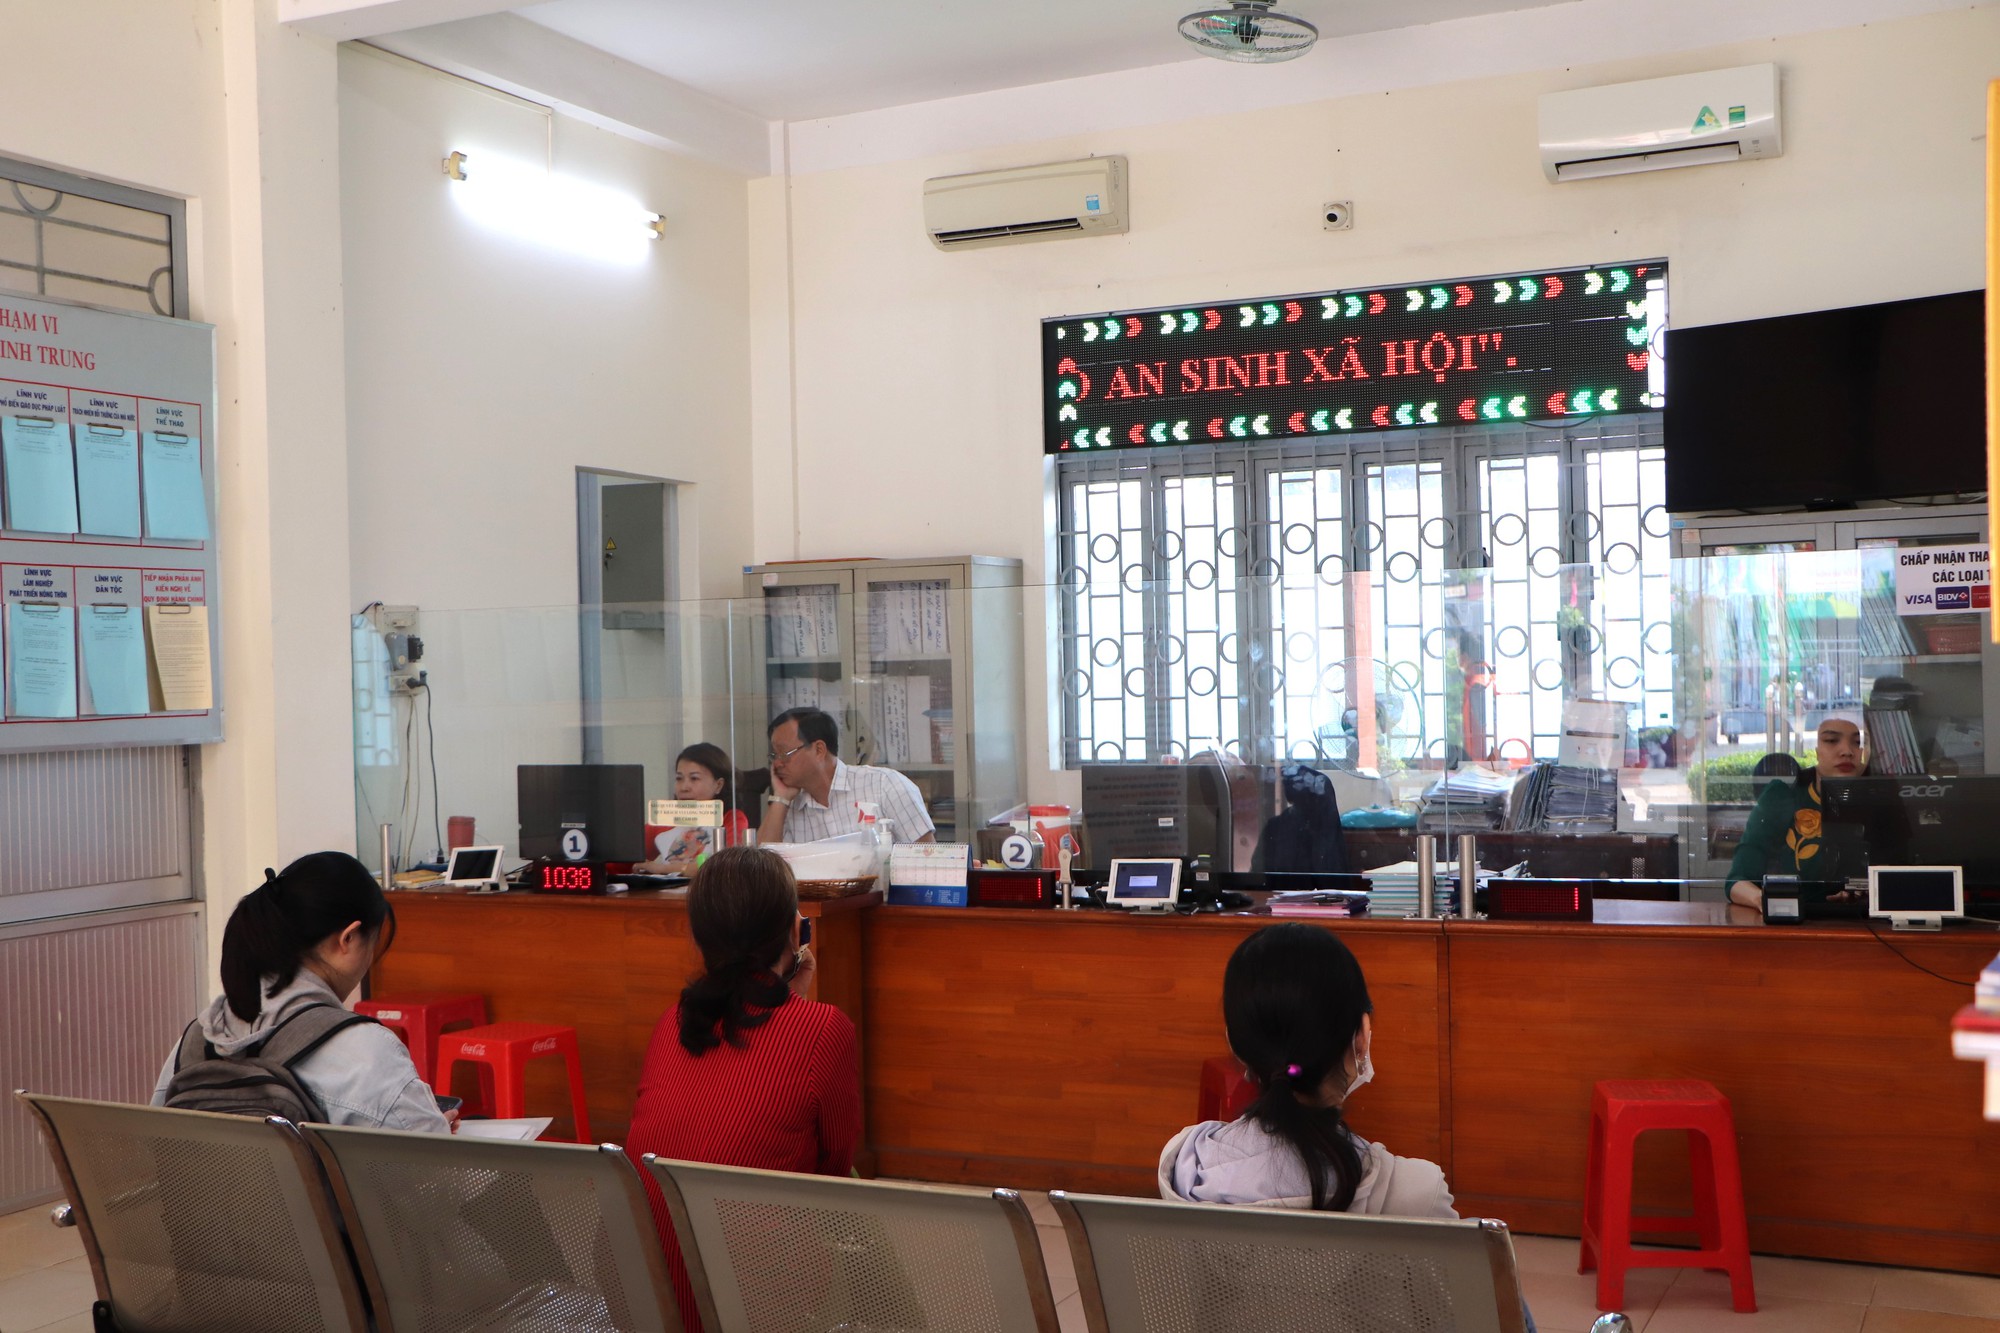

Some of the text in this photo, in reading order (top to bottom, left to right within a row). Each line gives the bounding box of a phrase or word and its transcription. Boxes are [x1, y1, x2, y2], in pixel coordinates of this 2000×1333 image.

[41, 315, 59, 335] VI
[37, 345, 96, 371] TRUNG
[1105, 361, 1168, 400] AN
[1181, 351, 1291, 394] SINH
[1302, 337, 1371, 383] XÃ
[169, 419, 184, 427] THAO
[1900, 550, 1930, 566] CHẤP
[1933, 550, 1965, 566] NHẬN
[1932, 569, 1955, 583] CÁC
[1958, 570, 1984, 583] LOẠI
[1904, 594, 1932, 604] VISA
[1937, 593, 1959, 601] BIDV
[1899, 784, 1953, 797] acer
[568, 835, 582, 853] 1
[1008, 842, 1026, 863] 2
[543, 866, 591, 889] 1038
